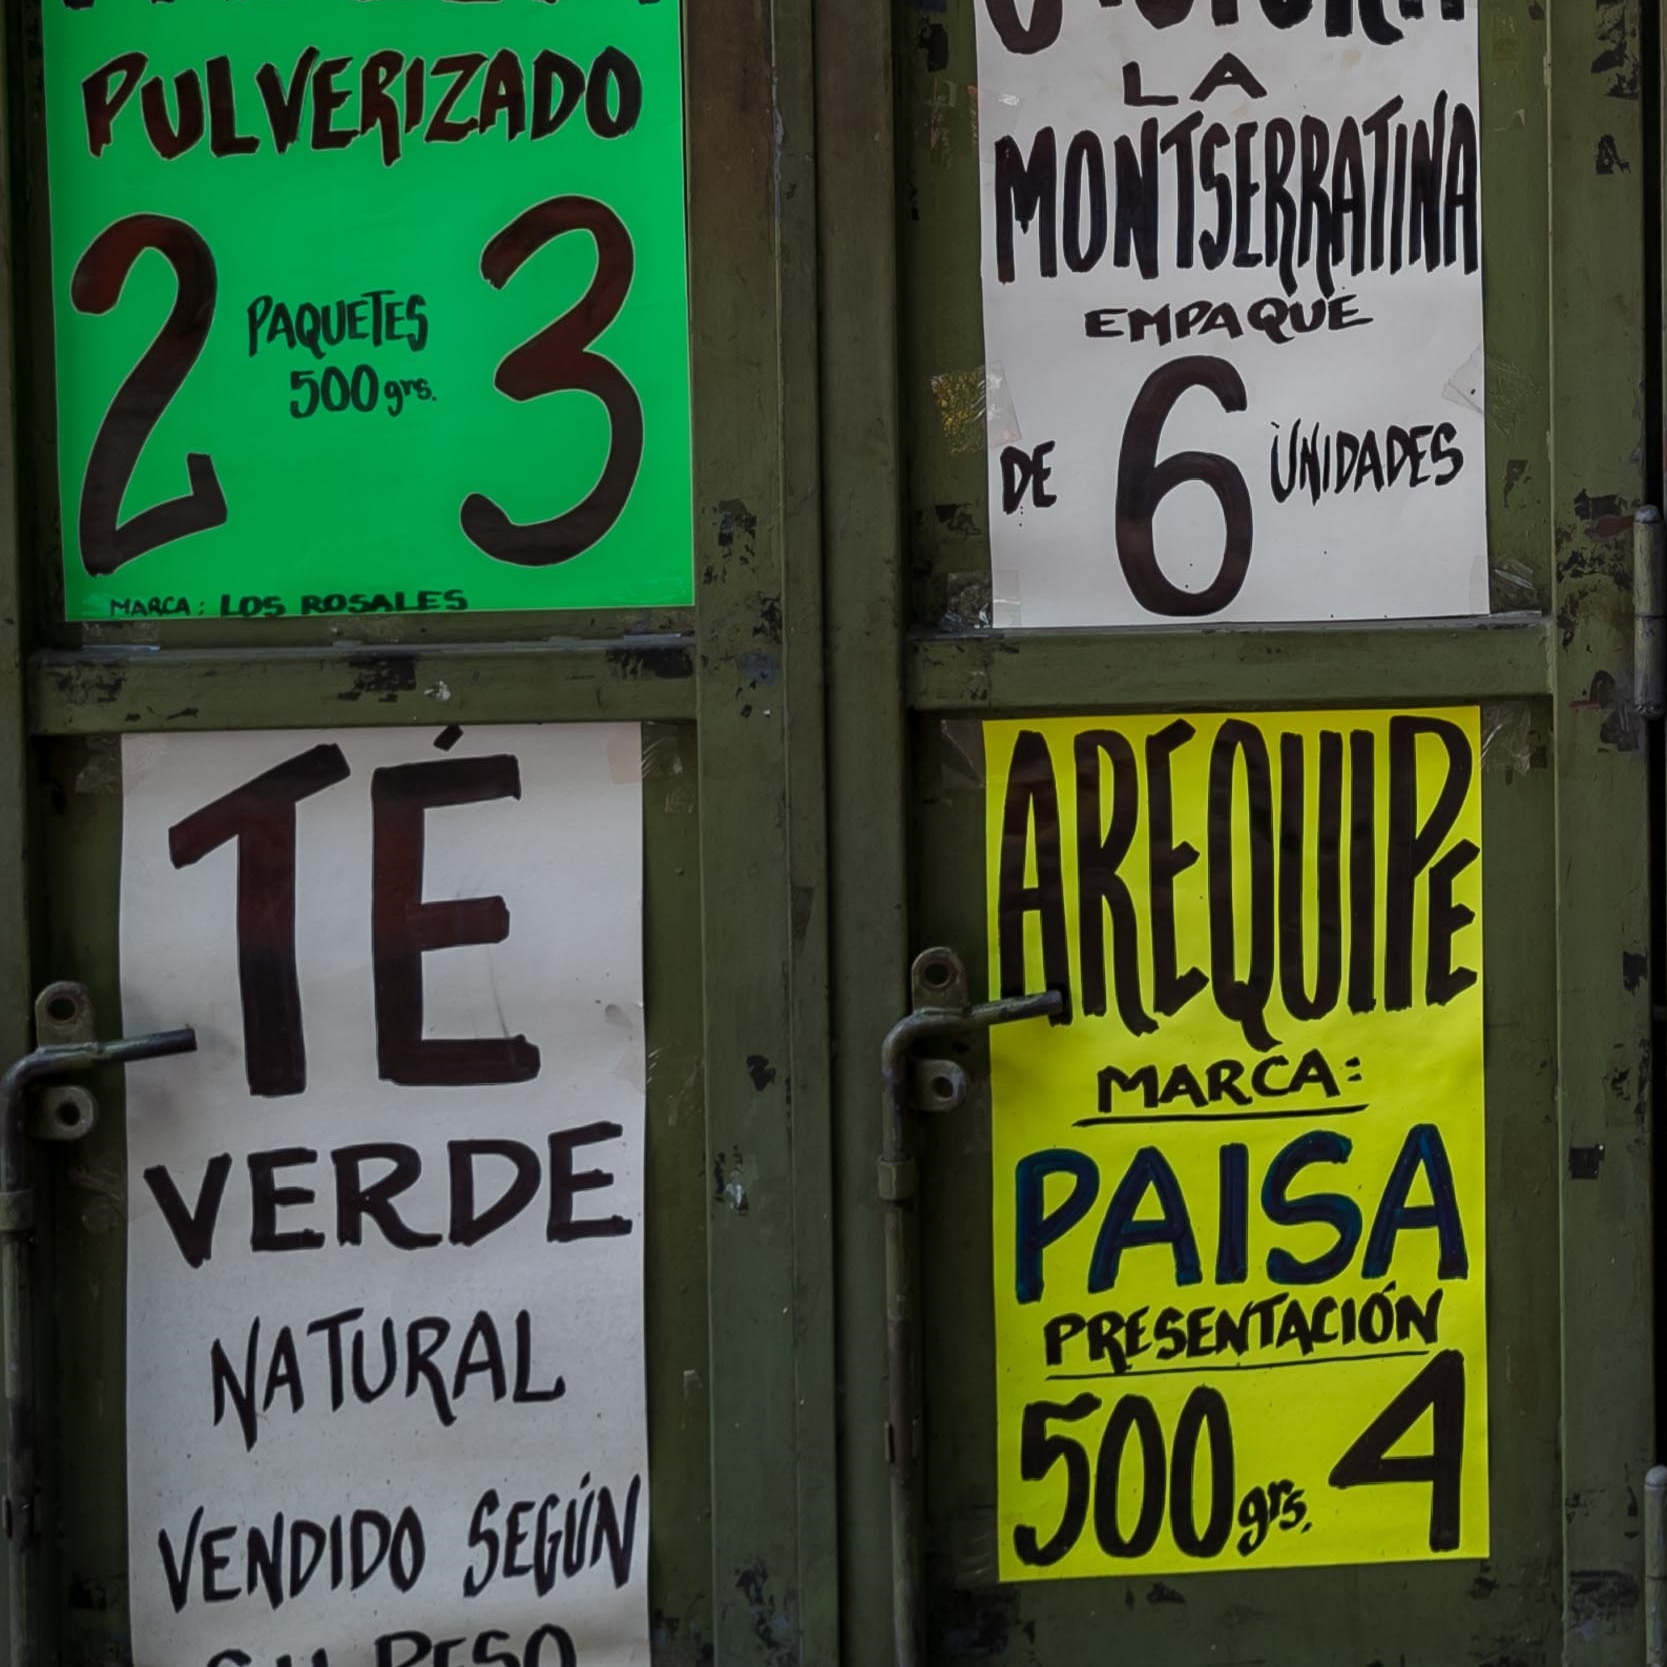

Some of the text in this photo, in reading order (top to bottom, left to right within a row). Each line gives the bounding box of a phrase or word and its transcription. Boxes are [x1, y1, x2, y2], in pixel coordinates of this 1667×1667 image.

[80, 46, 642, 167] PULVERIZADO
[1122, 52, 1268, 107] LA
[994, 89, 1479, 300] MONTSERRATINA
[70, 195, 644, 579] 2 PAQUETES 3
[1084, 294, 1374, 347] EMPAQUE
[999, 355, 1464, 617] DE 6 UNIDADES
[219, 592, 288, 619] LOS
[302, 589, 467, 615] ROSALES
[169, 725, 541, 1097] TÉ
[999, 715, 1480, 1051] AREQUIPE
[1096, 1048, 1362, 1114] MARCA:
[142, 1121, 633, 1269] VERDE
[1014, 1123, 1469, 1305] PAISA
[210, 1307, 566, 1453] NATURAL
[1329, 1349, 1466, 1552] 4
[157, 1472, 641, 1614] VENDIDO SEGÚN
